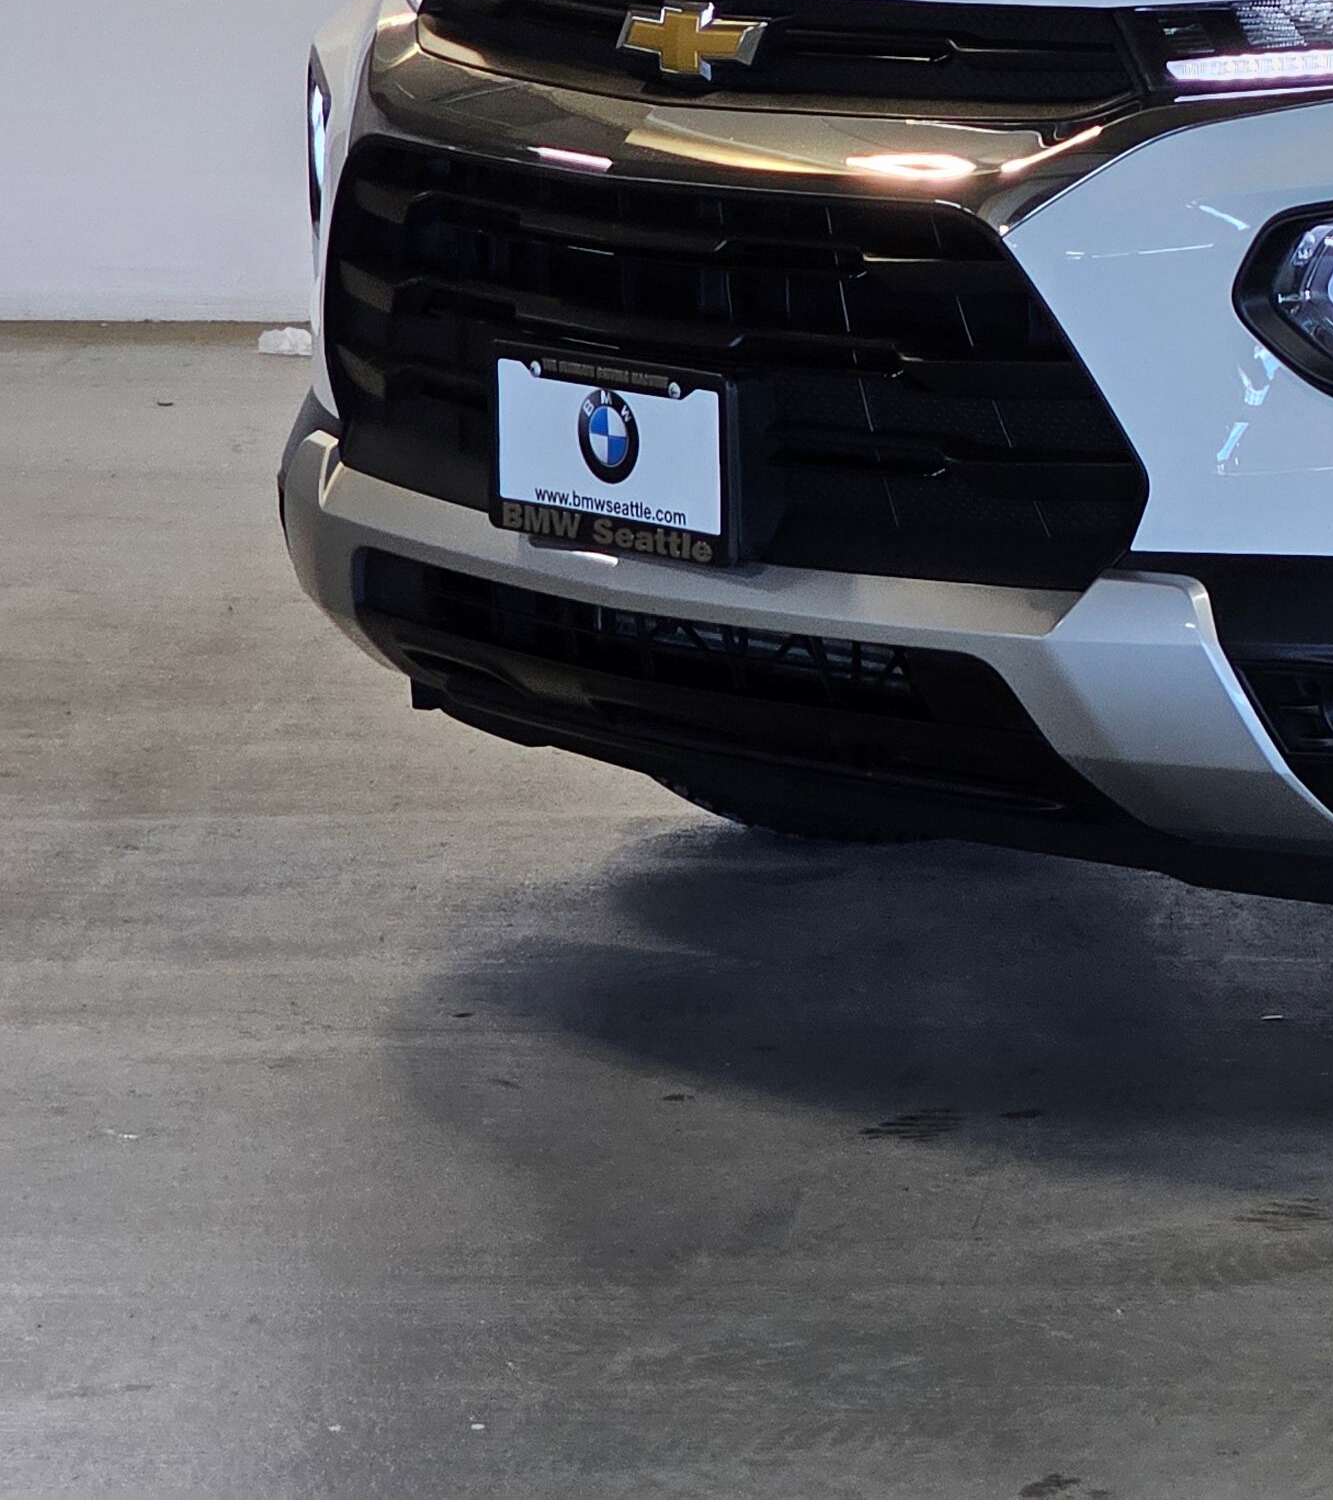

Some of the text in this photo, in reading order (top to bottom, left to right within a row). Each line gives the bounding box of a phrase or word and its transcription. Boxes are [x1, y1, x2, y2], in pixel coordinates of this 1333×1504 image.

[582, 389, 632, 423] BMW
[535, 488, 686, 526] www.bmwseattle.com
[502, 502, 712, 563] BMW Seattle
